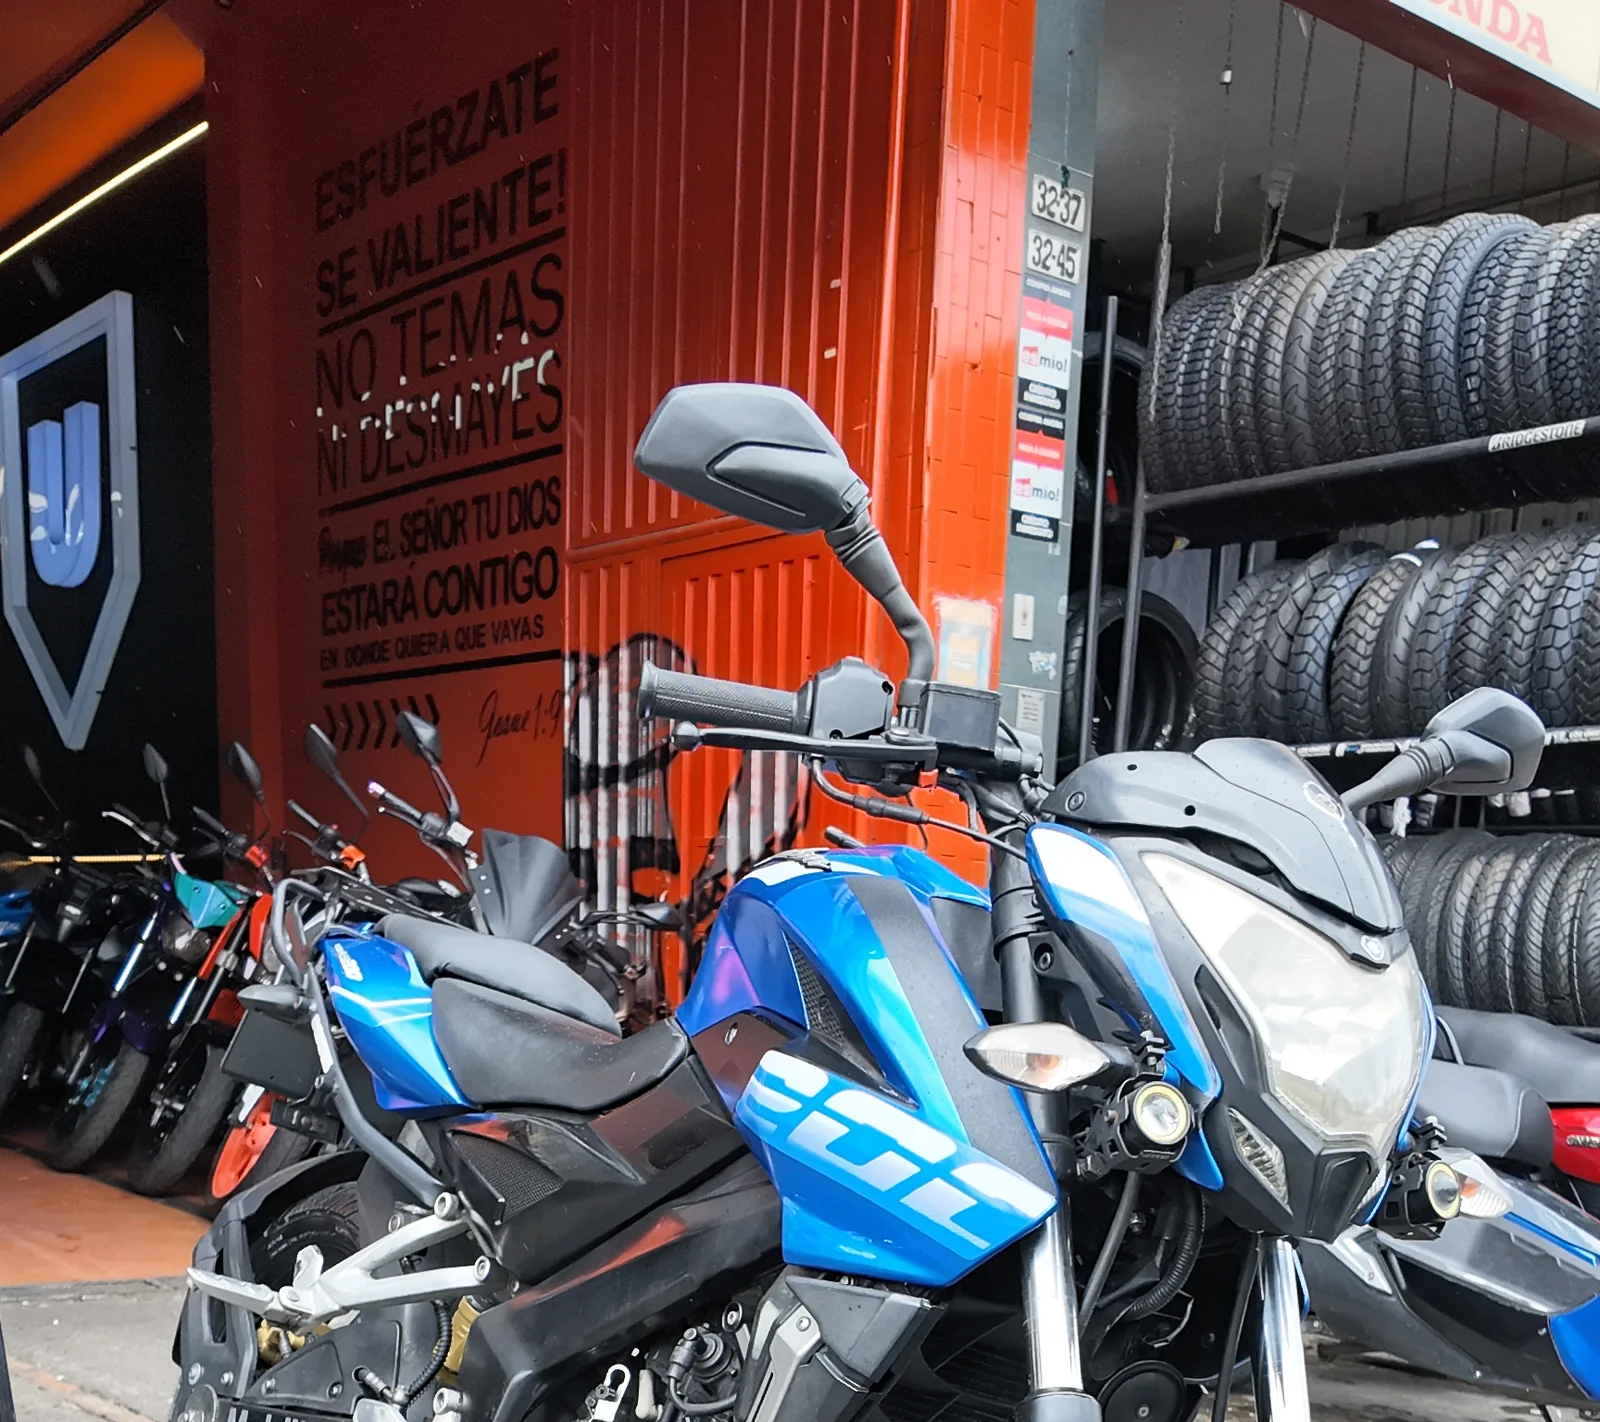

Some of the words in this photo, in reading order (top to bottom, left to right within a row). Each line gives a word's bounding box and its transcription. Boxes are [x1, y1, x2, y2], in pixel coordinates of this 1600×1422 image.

[316, 245, 358, 318] SE
[367, 147, 568, 292] VALIENTE!
[1032, 235, 1080, 280] 32-45
[316, 328, 377, 418] NO
[391, 252, 565, 386] TEMAS
[316, 422, 348, 497] NI
[359, 348, 565, 483] DESMAYES
[400, 496, 468, 558] SEÑOR
[472, 490, 502, 543] TU
[506, 474, 562, 535] DIOS
[321, 560, 420, 637] ESTARÁ
[423, 545, 559, 619] CONTIGO
[320, 647, 339, 671] EN
[344, 638, 390, 668] DONDE
[394, 630, 450, 660] QUIERA
[454, 623, 487, 652] QUE
[491, 613, 545, 645] VAYAS
